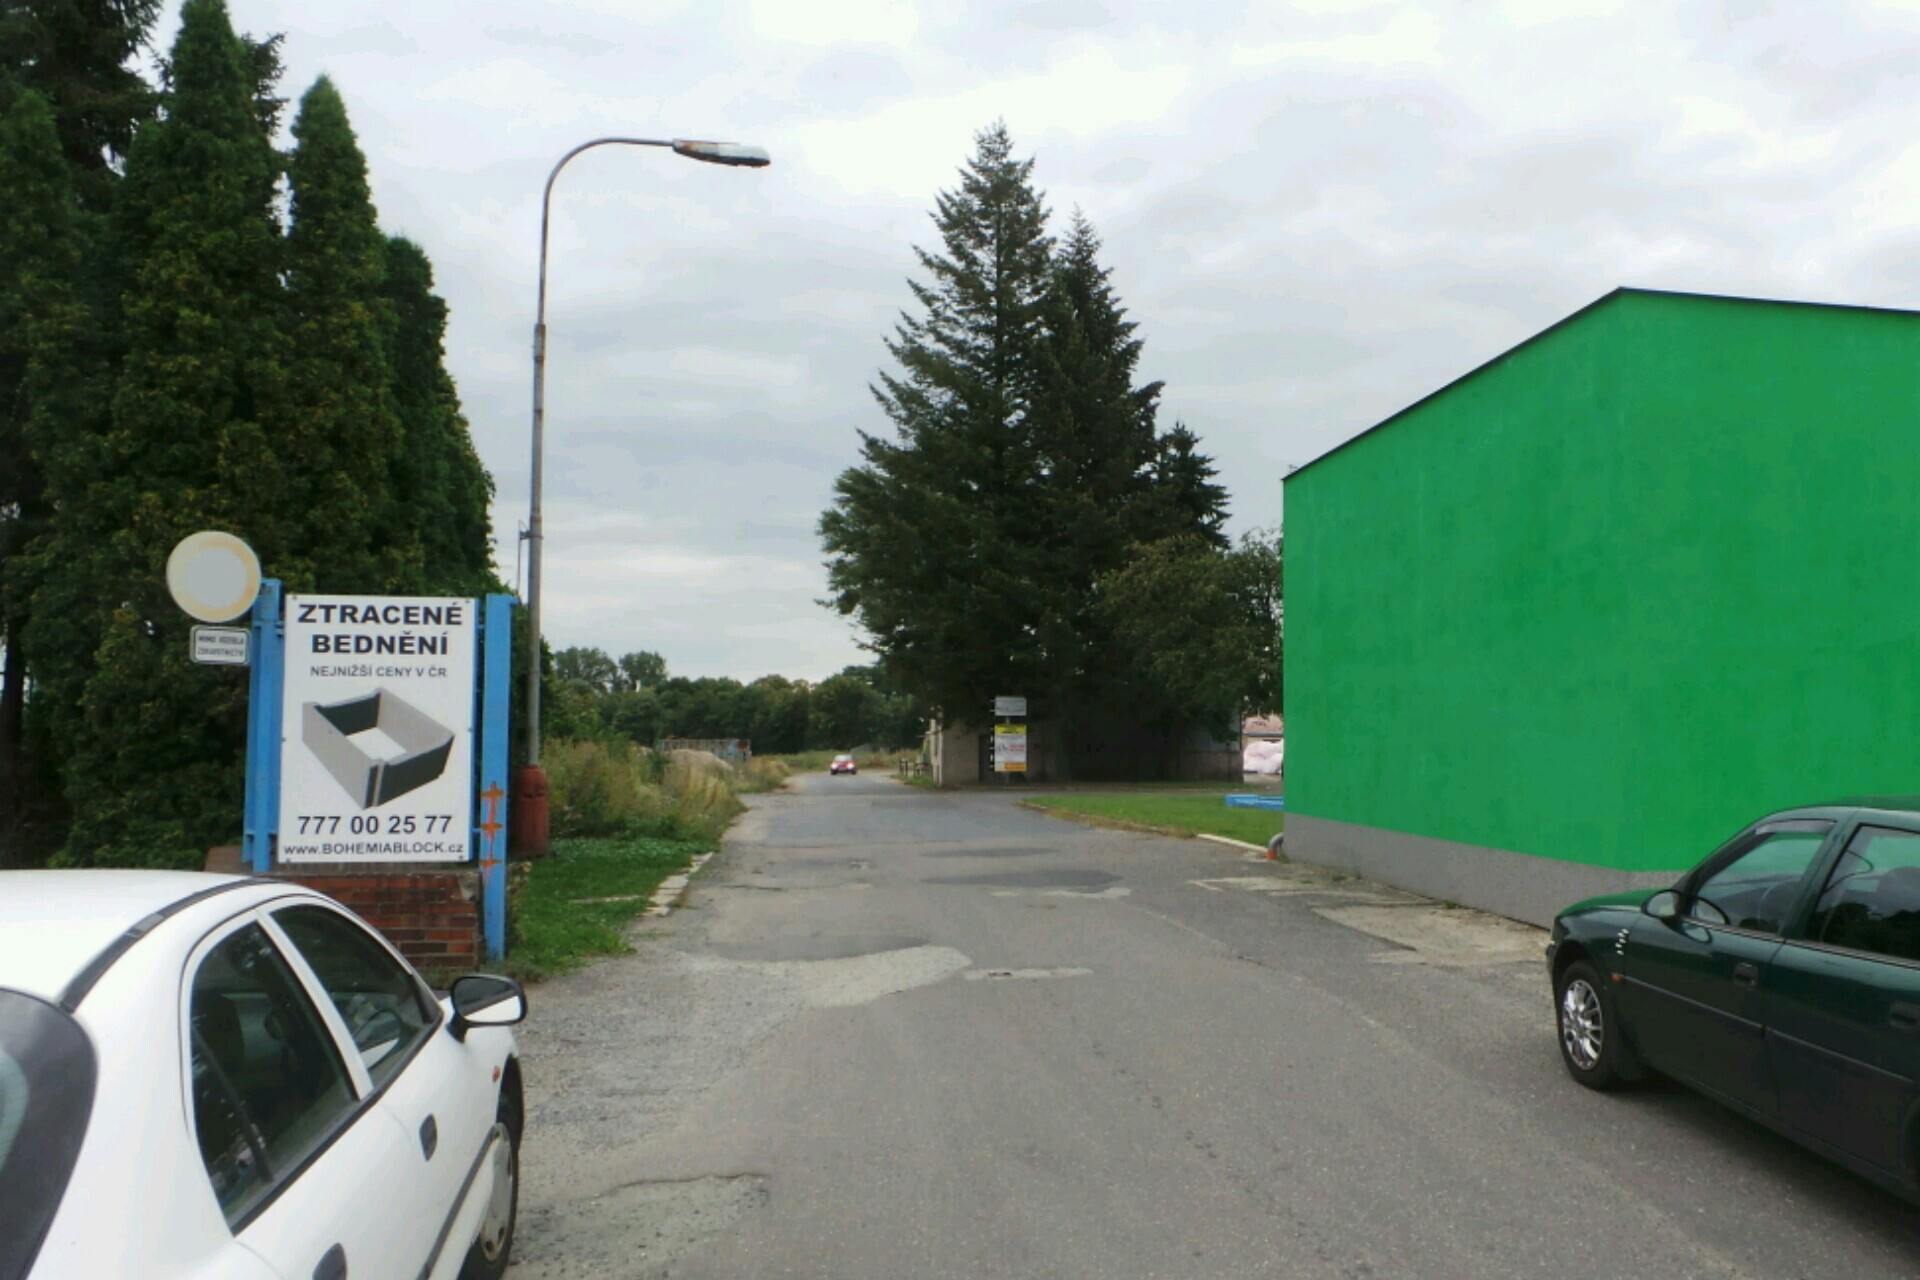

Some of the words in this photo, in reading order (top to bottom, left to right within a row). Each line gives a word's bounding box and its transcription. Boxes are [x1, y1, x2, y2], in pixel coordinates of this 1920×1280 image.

[298, 602, 462, 626] ZTRACENÉ
[312, 630, 448, 655] BEDNĚNÍ
[310, 664, 373, 677] NEJNIŽŠÍ
[376, 666, 412, 677] CENY
[415, 668, 425, 677] V
[428, 665, 447, 677] ČR
[298, 815, 341, 835] 777
[350, 815, 379, 835] 00
[388, 815, 416, 835] 25
[424, 814, 453, 834] 77
[284, 841, 463, 856] www.BOHEMIABLOCK.cz
